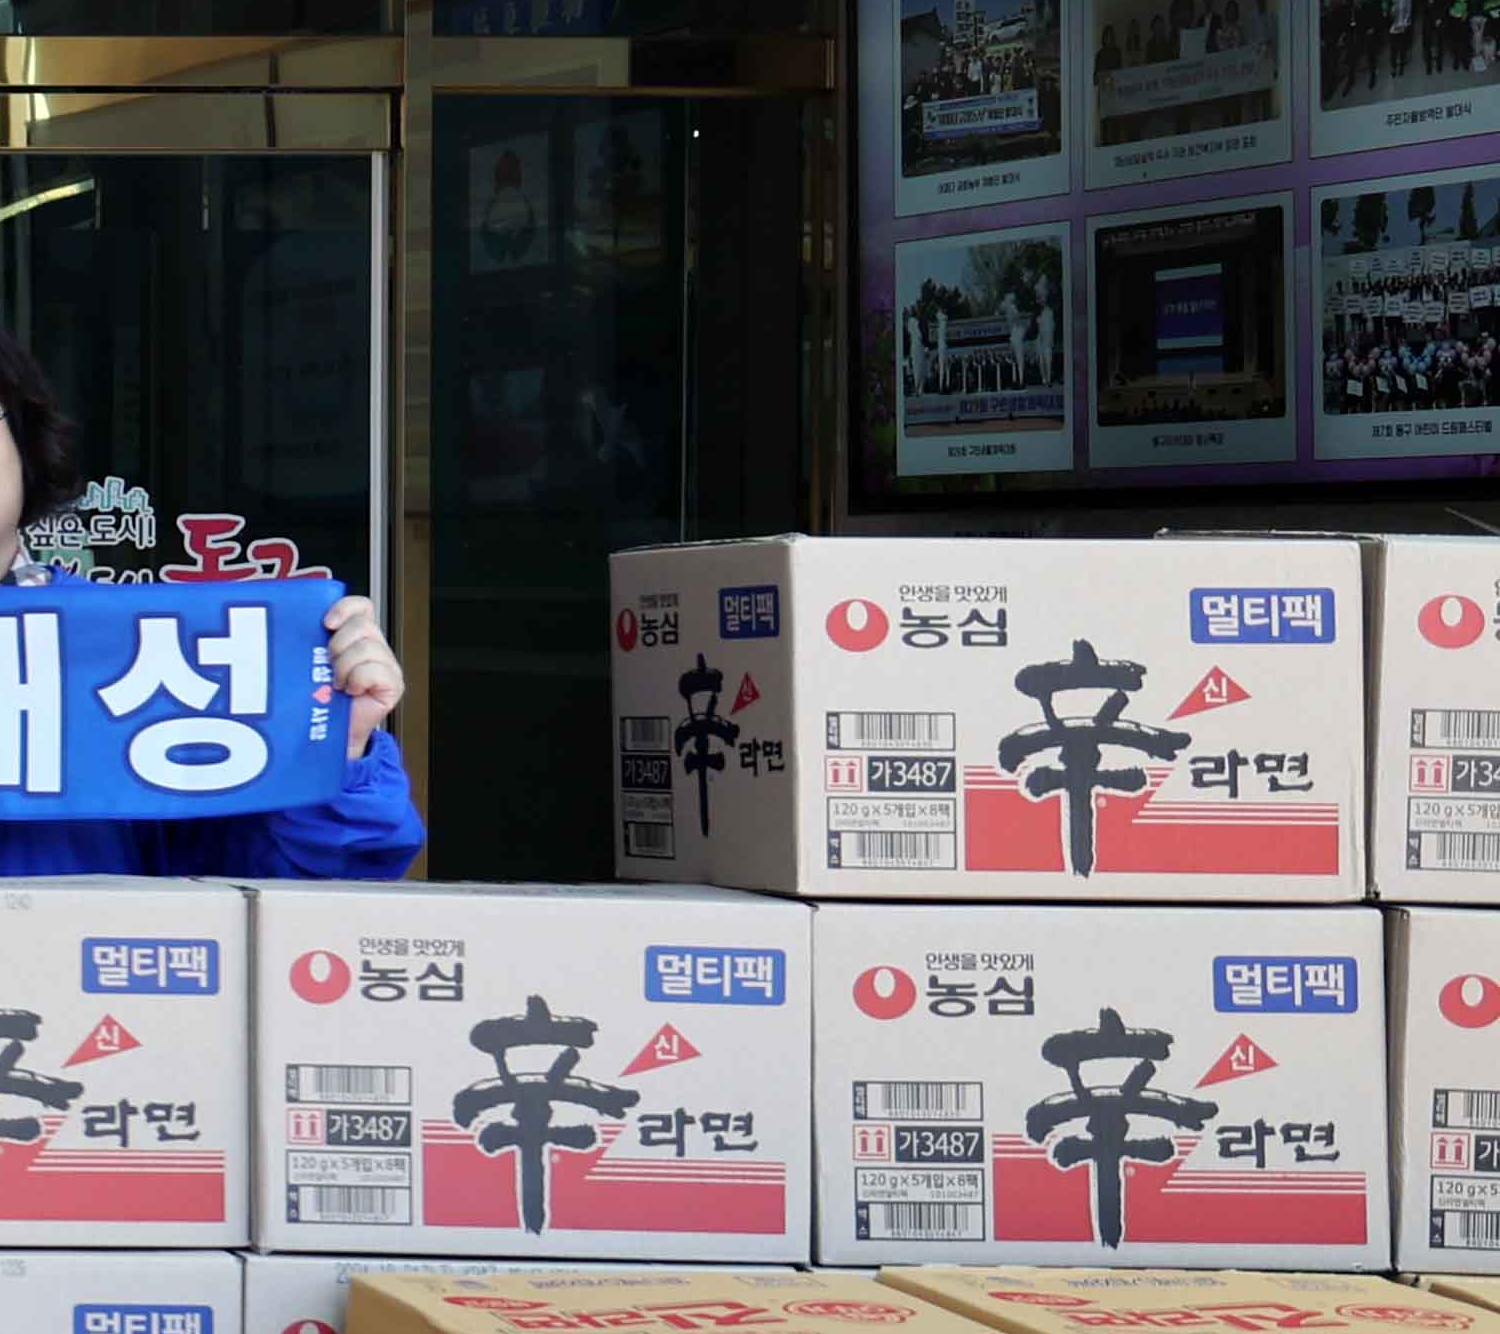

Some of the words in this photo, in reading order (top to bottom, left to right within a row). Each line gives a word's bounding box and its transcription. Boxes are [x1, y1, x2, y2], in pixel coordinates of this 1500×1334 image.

[26, 516, 84, 549] 싶은
[89, 515, 156, 549] 도시!
[898, 605, 1008, 649] 농심
[1201, 593, 1323, 638] 멀티팩
[871, 760, 952, 791] 가3487
[998, 638, 1192, 879] 辛
[91, 944, 209, 988] 멀티팩
[81, 1099, 201, 1147] 라면
